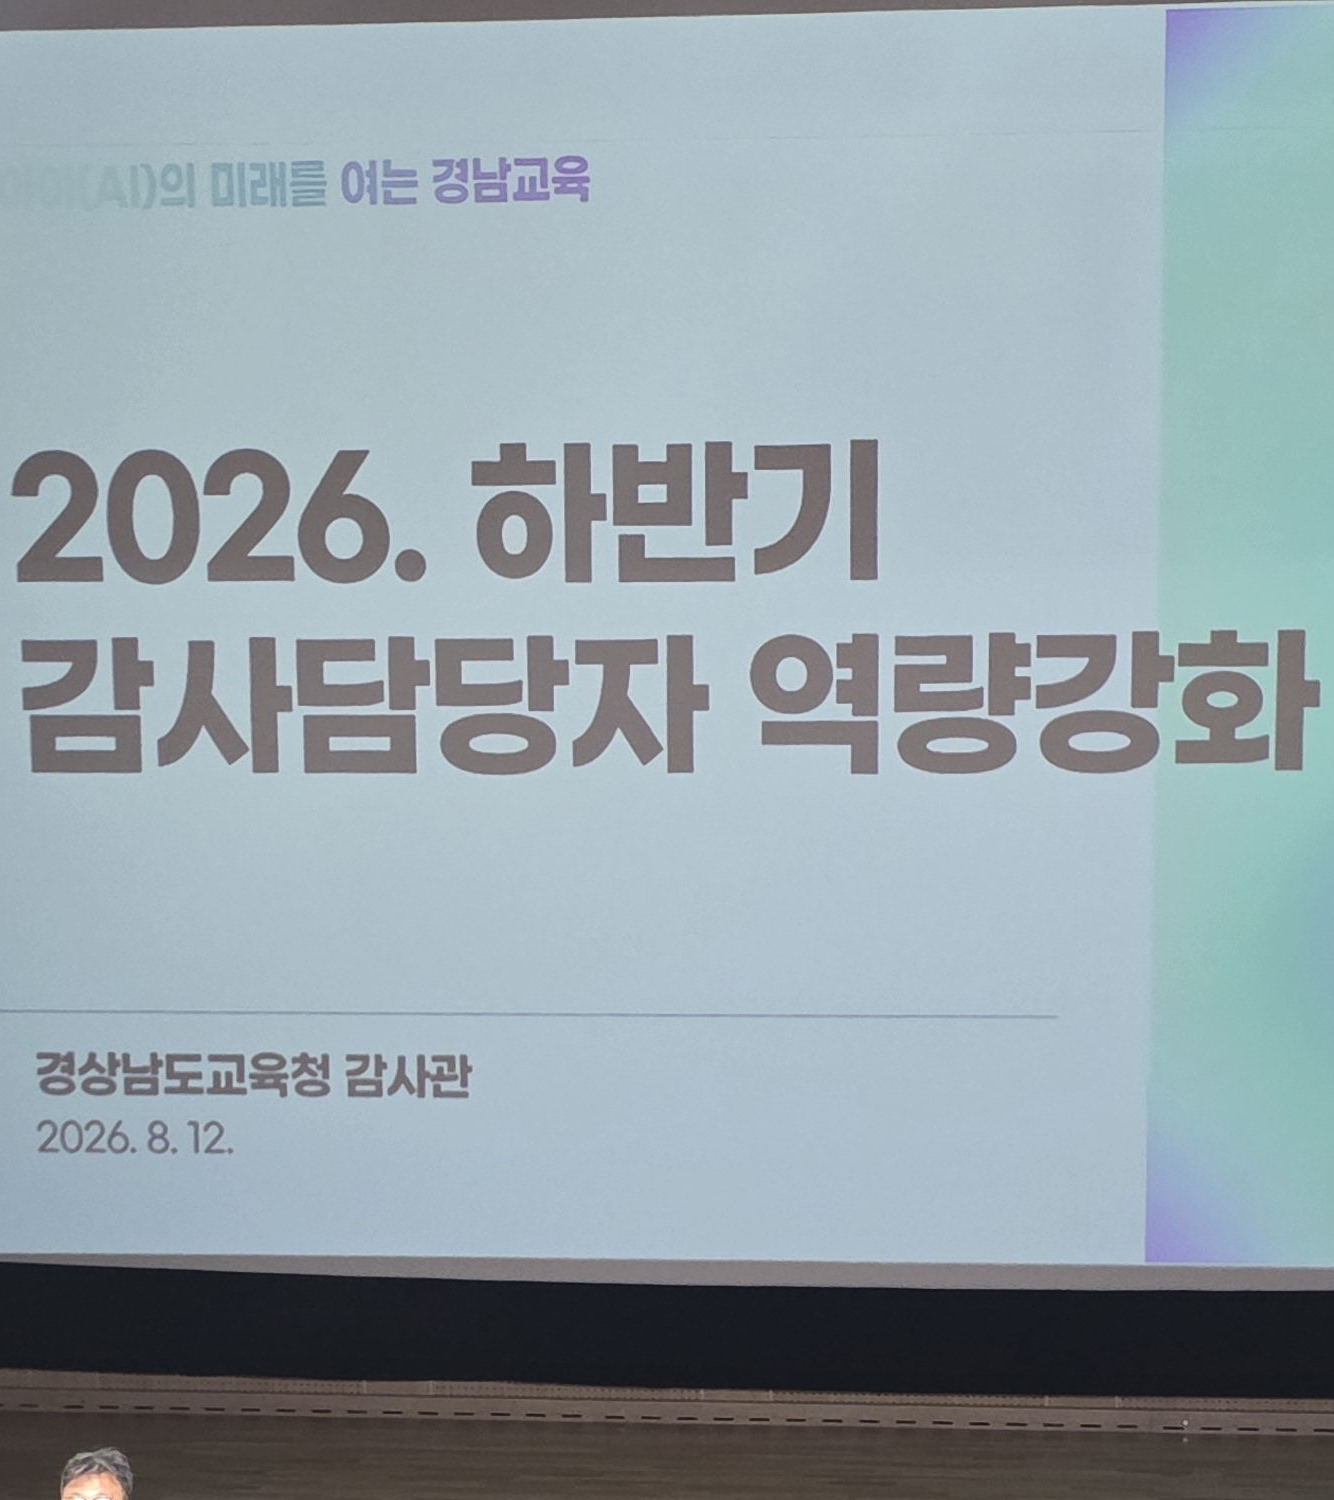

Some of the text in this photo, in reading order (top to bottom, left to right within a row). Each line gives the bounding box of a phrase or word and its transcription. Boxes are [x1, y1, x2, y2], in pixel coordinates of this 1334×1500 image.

[210, 159, 328, 208] 미래를
[340, 158, 419, 206] 여는
[431, 155, 591, 205] 경남교육
[10, 438, 879, 586] 2026. 하반기
[20, 634, 710, 776] 감사담당자
[749, 629, 1321, 775] 역량강화
[35, 1050, 473, 1099] 경상남도교육청 감사관
[36, 1119, 234, 1155] 2026. 8. 12.
